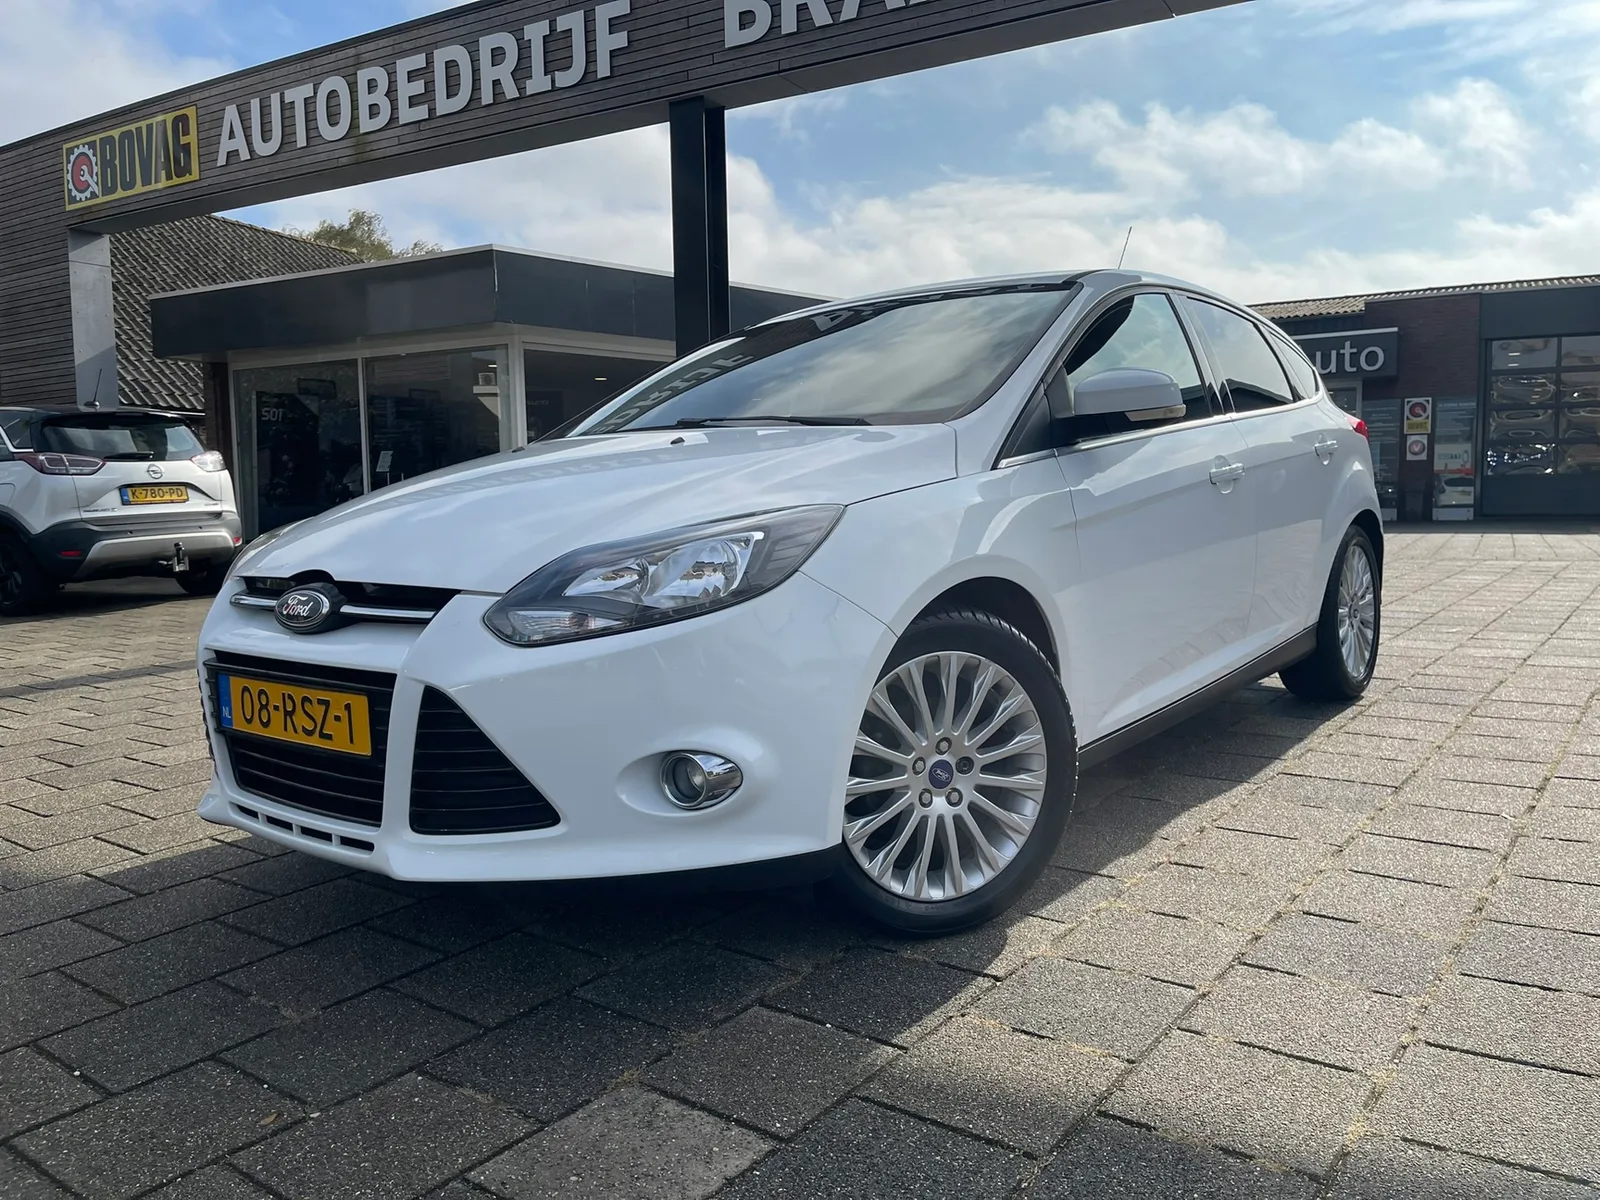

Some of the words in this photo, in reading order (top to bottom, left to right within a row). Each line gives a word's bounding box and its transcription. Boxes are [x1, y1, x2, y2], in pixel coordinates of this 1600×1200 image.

[217, 0, 631, 167] AUTOBEDRIJF
[99, 113, 193, 198] BOVAG
[130, 487, 184, 500] K-780-PD
[282, 594, 314, 617] Ford
[222, 706, 232, 719] NL
[240, 684, 355, 745] 08-RSZ-1
